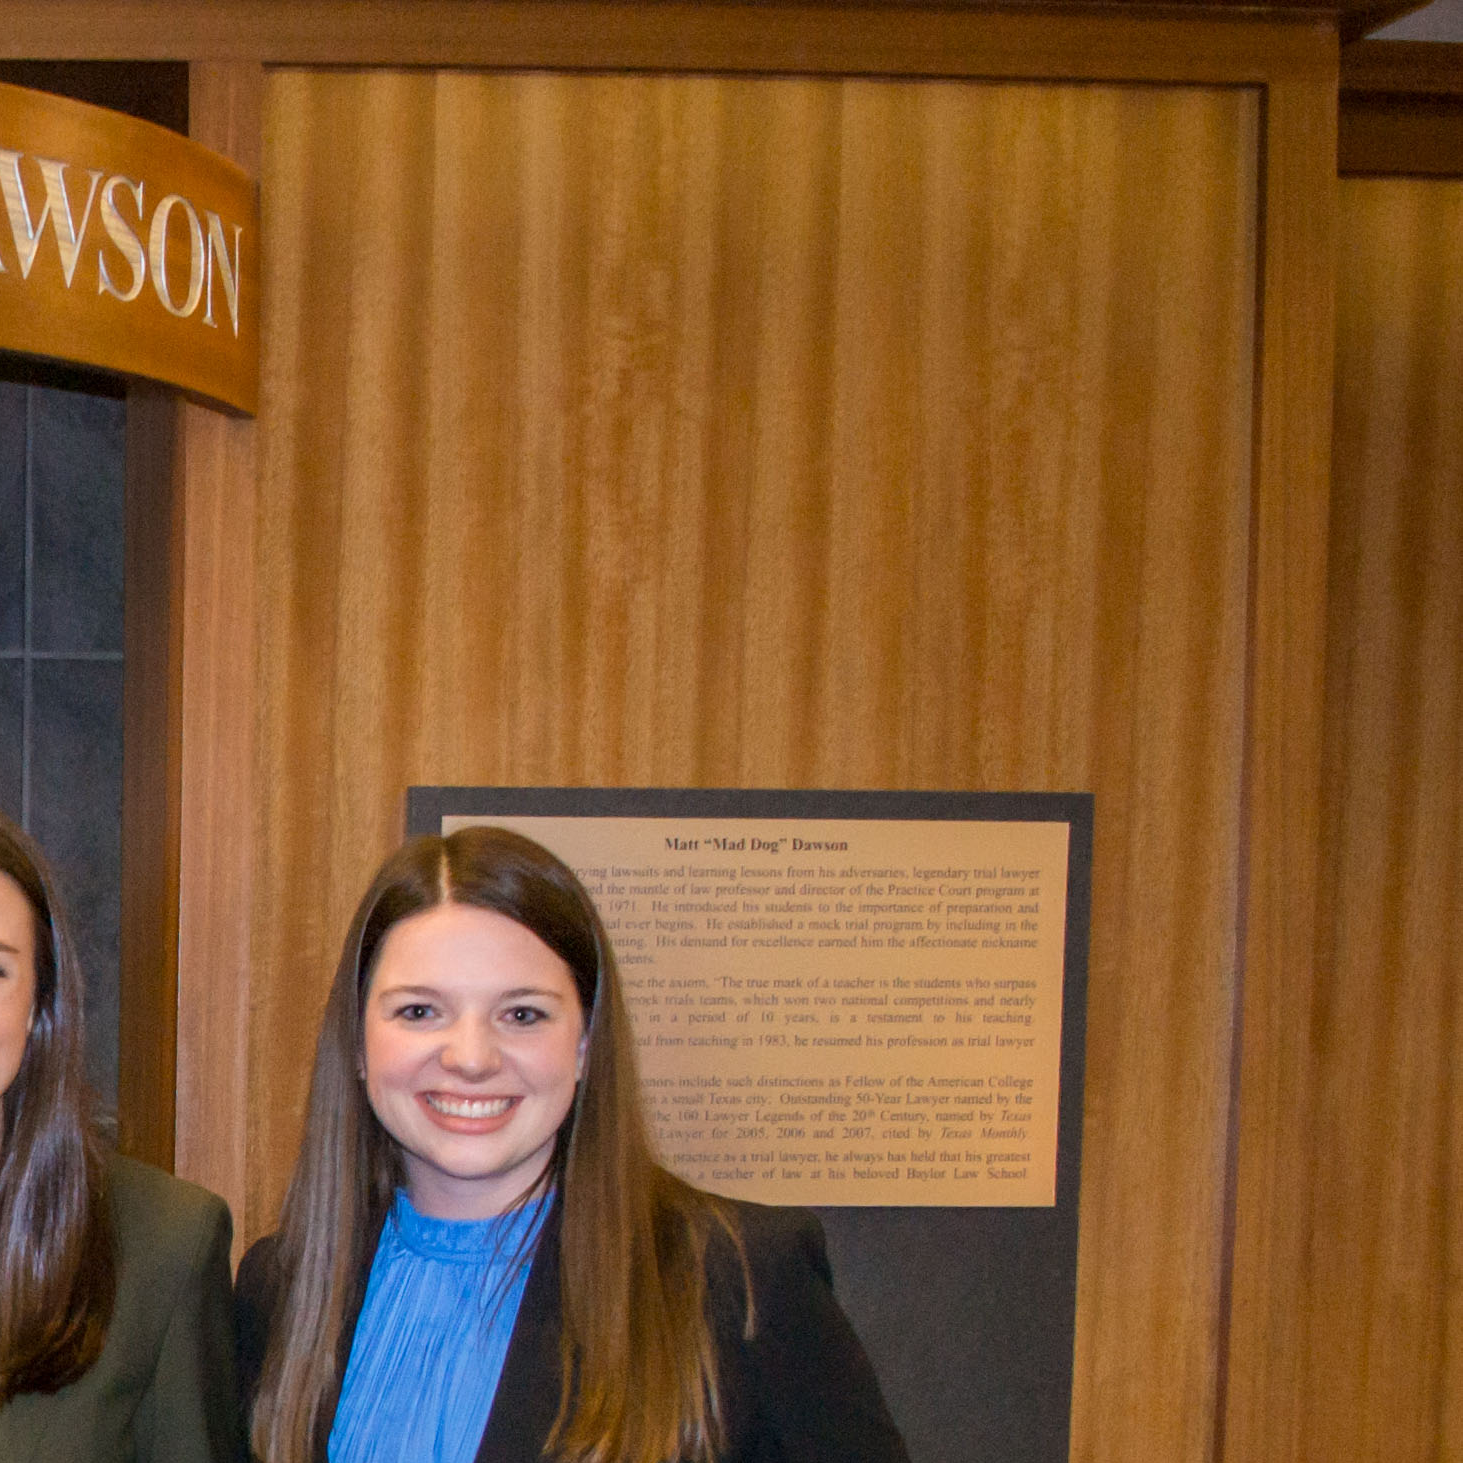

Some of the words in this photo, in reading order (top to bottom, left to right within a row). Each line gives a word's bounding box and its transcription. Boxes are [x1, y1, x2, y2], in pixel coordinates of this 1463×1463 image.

[664, 837, 700, 851] Matt
[791, 838, 849, 852] Dawson
[611, 865, 659, 879] lawsuits
[662, 865, 686, 879] and
[688, 865, 737, 882] learning
[740, 865, 782, 879] lessons
[786, 865, 815, 879] from
[818, 865, 836, 879] his
[912, 865, 970, 882] legendary
[973, 865, 998, 879] trial
[1000, 865, 1041, 882] lawyer
[606, 881, 625, 895] the
[628, 881, 670, 895] mantle
[673, 881, 687, 895] of
[689, 881, 711, 895] law
[714, 882, 772, 899] professor
[774, 882, 796, 895] and
[799, 882, 846, 895] director
[848, 882, 863, 895] of
[865, 882, 884, 895] the
[887, 882, 936, 896] Practice
[937, 882, 971, 896] Court
[974, 886, 1026, 899] program
[678, 1074, 722, 1088] include
[726, 1074, 753, 1088] such
[756, 1074, 824, 1088] distinctions
[828, 1078, 841, 1088] as
[844, 1074, 886, 1088] Fellow
[889, 1074, 904, 1088] of
[906, 1074, 924, 1088] the
[927, 1074, 984, 1088] American
[988, 1074, 1034, 1091] College
